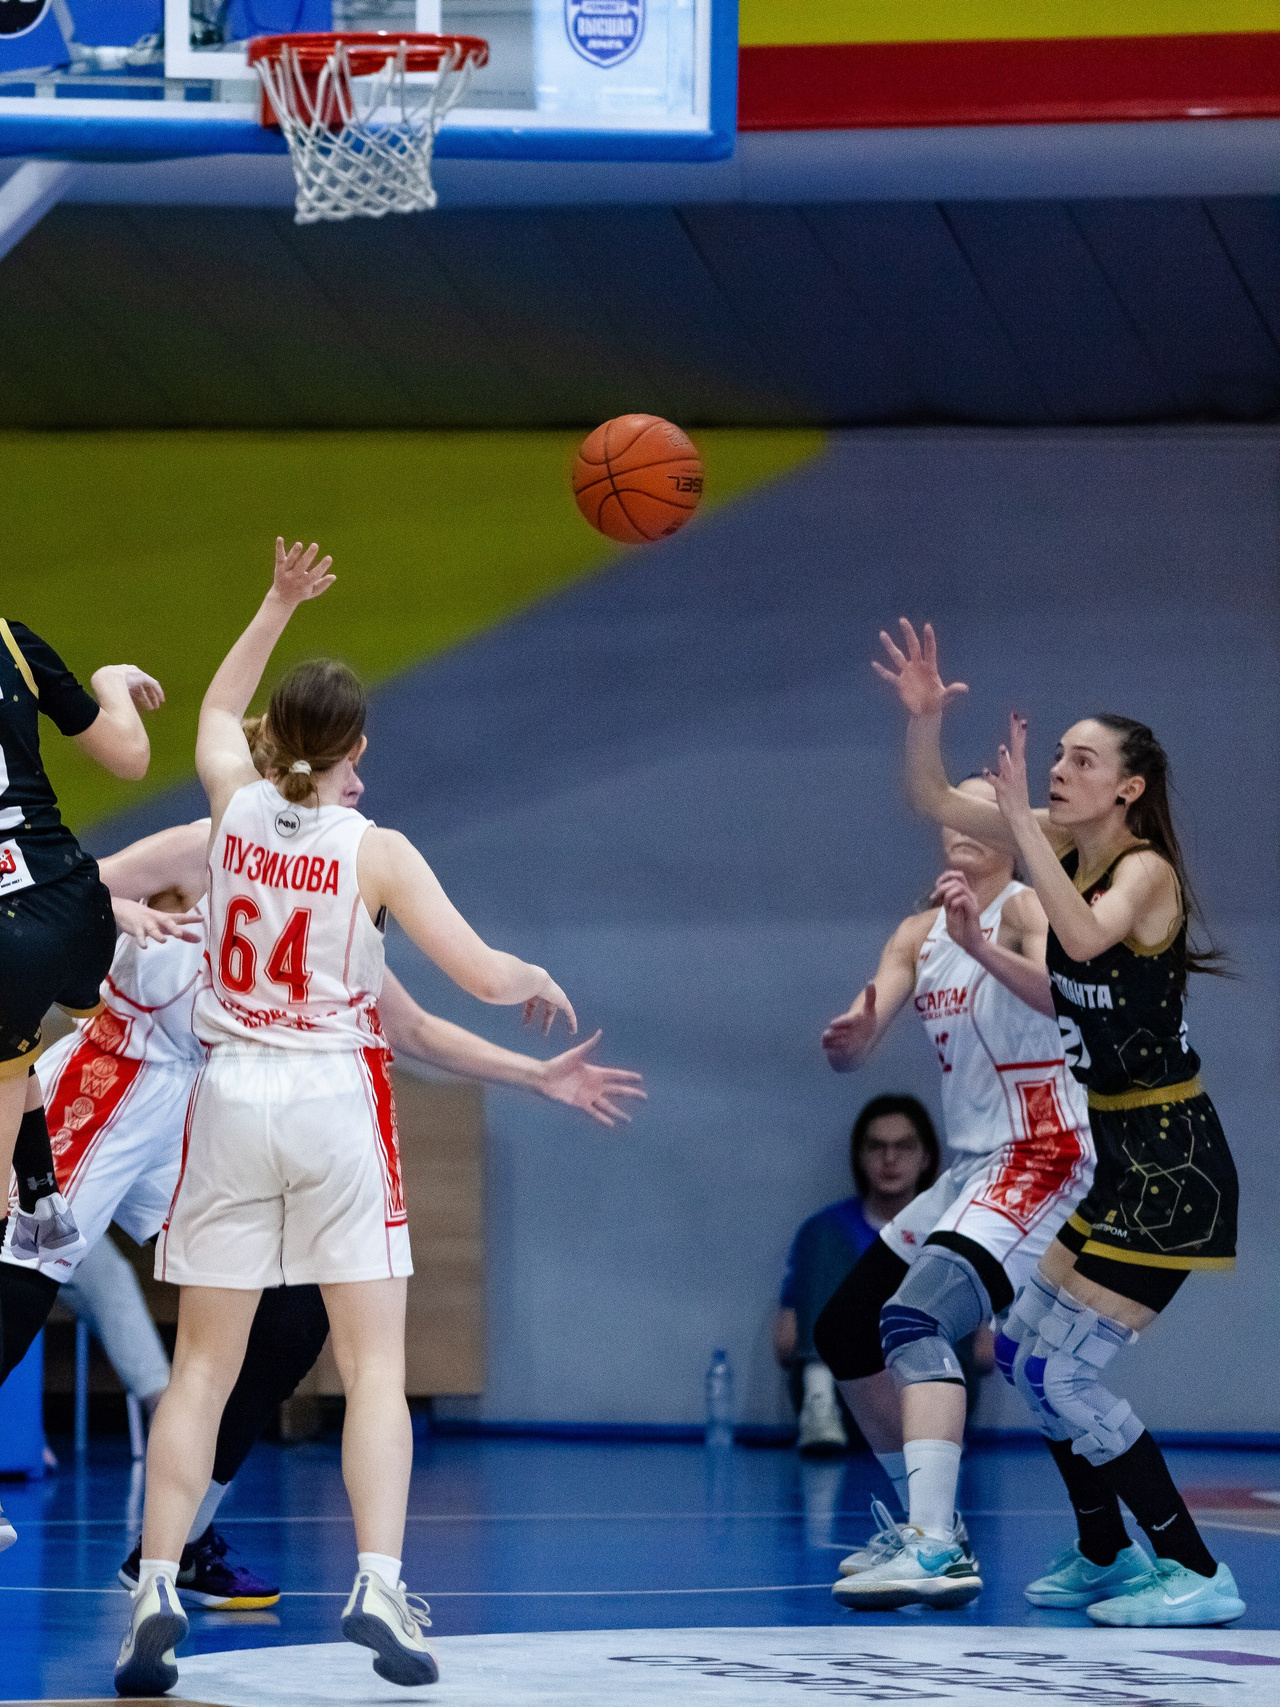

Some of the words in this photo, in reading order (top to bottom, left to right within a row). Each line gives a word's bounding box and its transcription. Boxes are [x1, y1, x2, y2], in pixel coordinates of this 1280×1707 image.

[222, 834, 340, 896] ПУЗИКОВА
[218, 894, 313, 1005] 64
[607, 1655, 957, 1701] СПОРТА
[962, 1651, 1246, 1686] ФОНД
